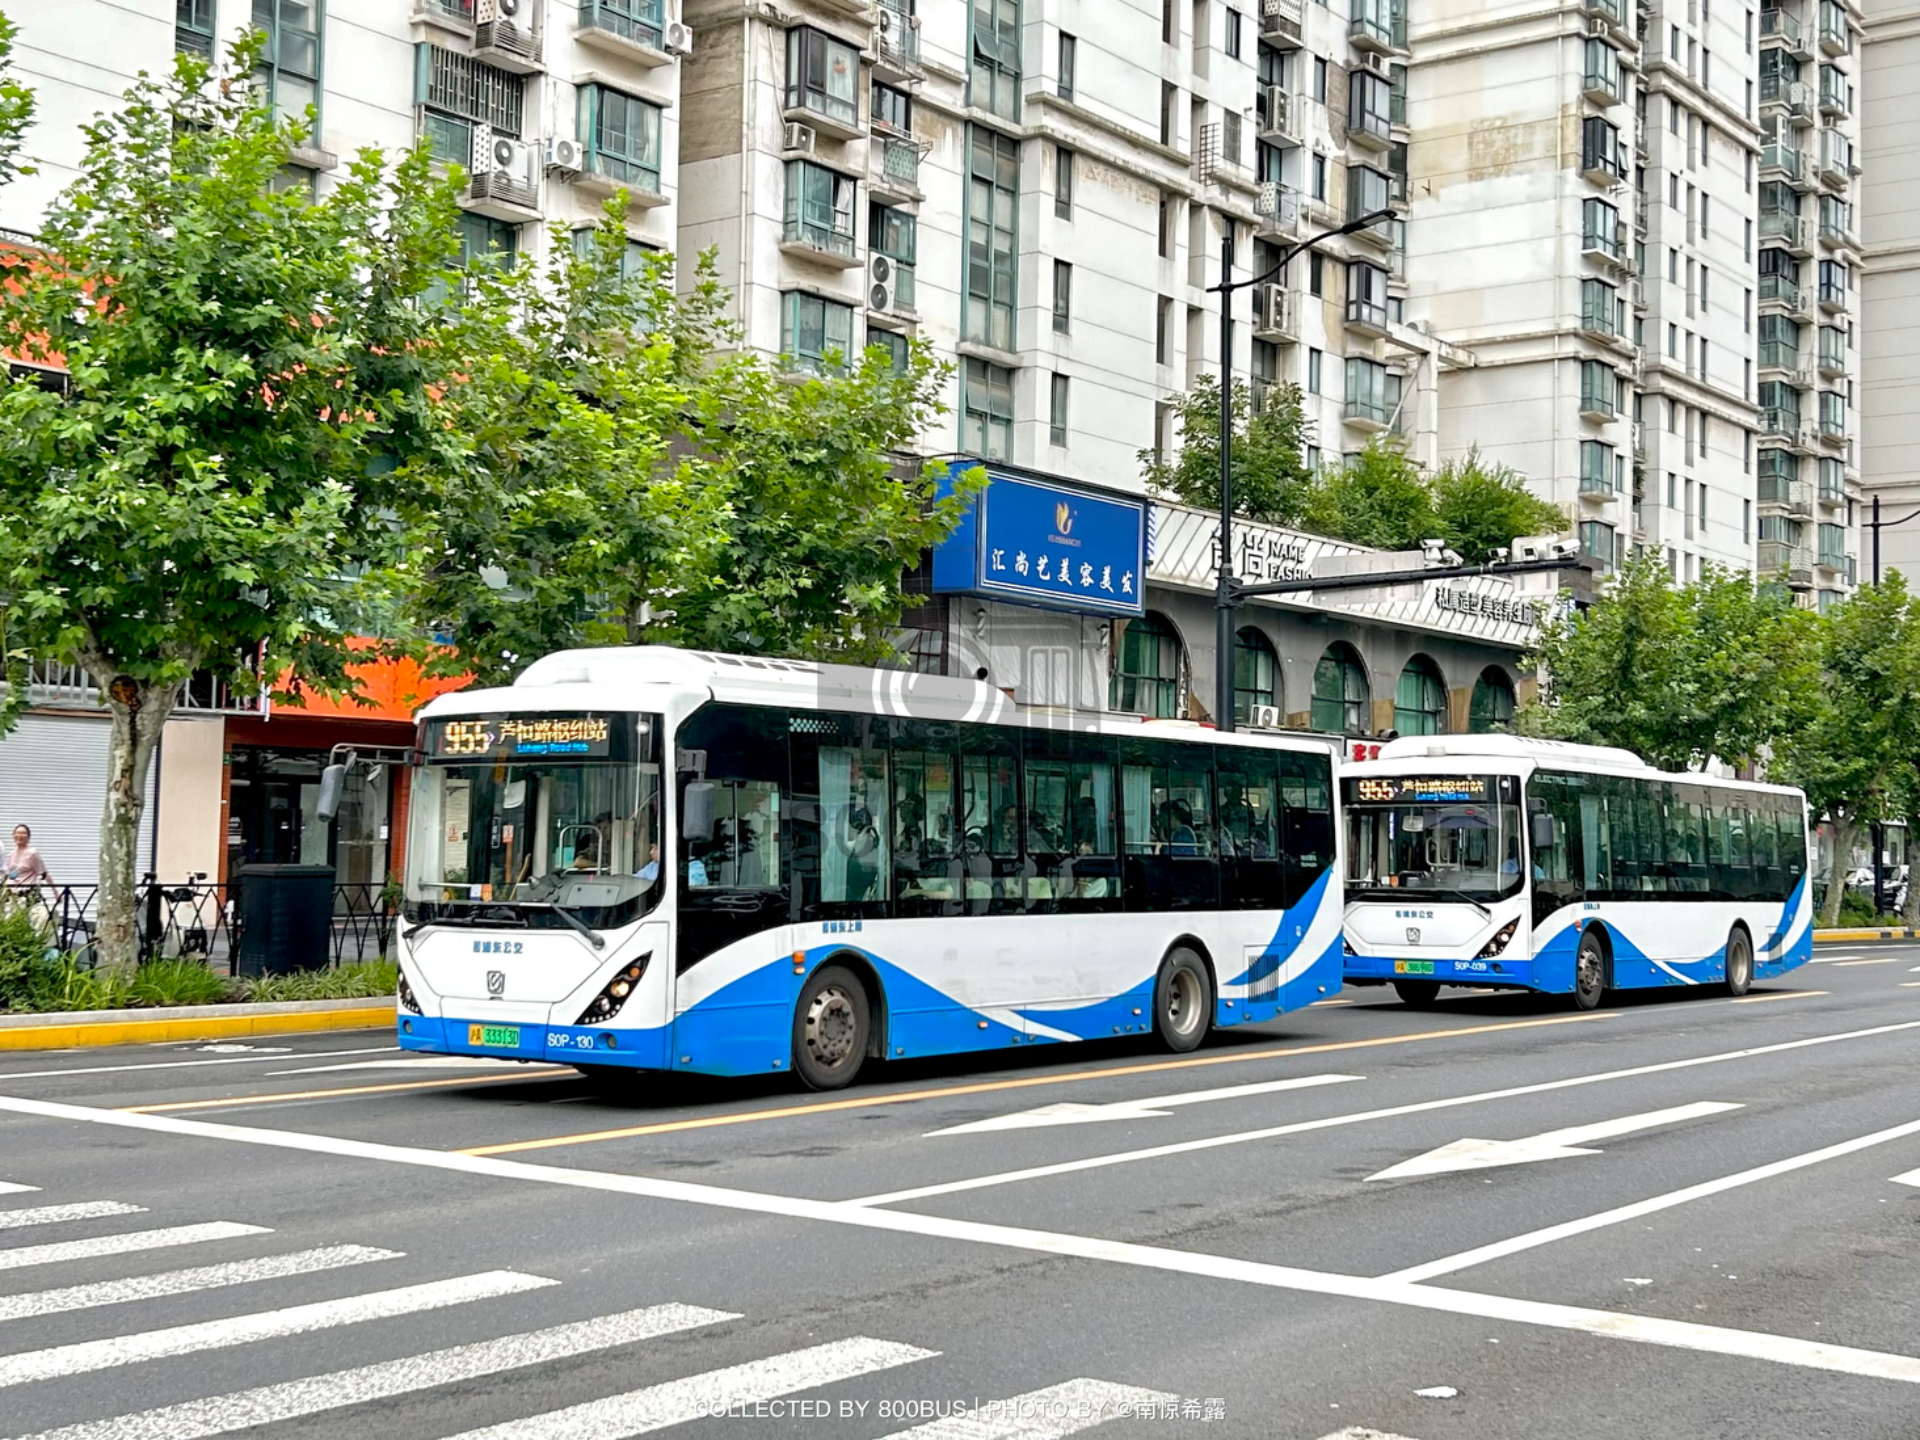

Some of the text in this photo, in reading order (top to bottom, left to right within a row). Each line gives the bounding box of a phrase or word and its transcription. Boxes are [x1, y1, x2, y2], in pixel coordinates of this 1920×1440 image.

[1267, 539, 1307, 564] NAME
[992, 548, 1133, 595] 汇尚艺美容美发
[444, 720, 490, 754] 955
[1358, 779, 1395, 801] 955
